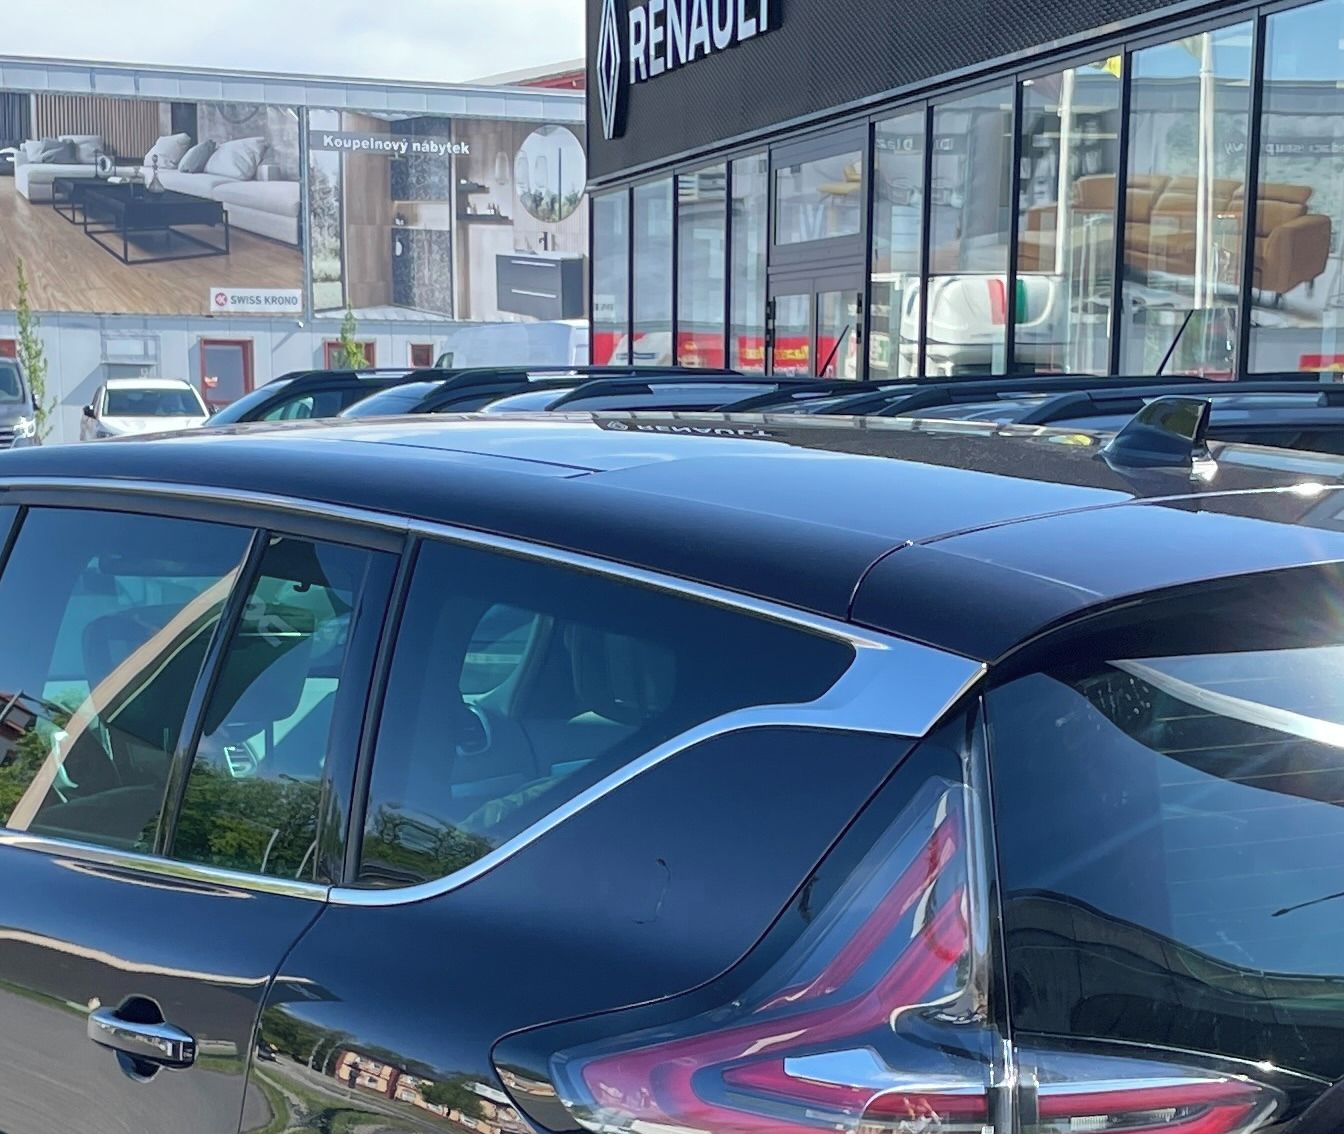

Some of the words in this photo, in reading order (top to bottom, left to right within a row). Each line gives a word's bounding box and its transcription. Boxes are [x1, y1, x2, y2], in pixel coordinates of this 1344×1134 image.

[323, 134, 409, 154] Koupelnový
[412, 140, 470, 156] nábytek
[230, 295, 262, 305] SWISS
[264, 296, 298, 306] KRONO
